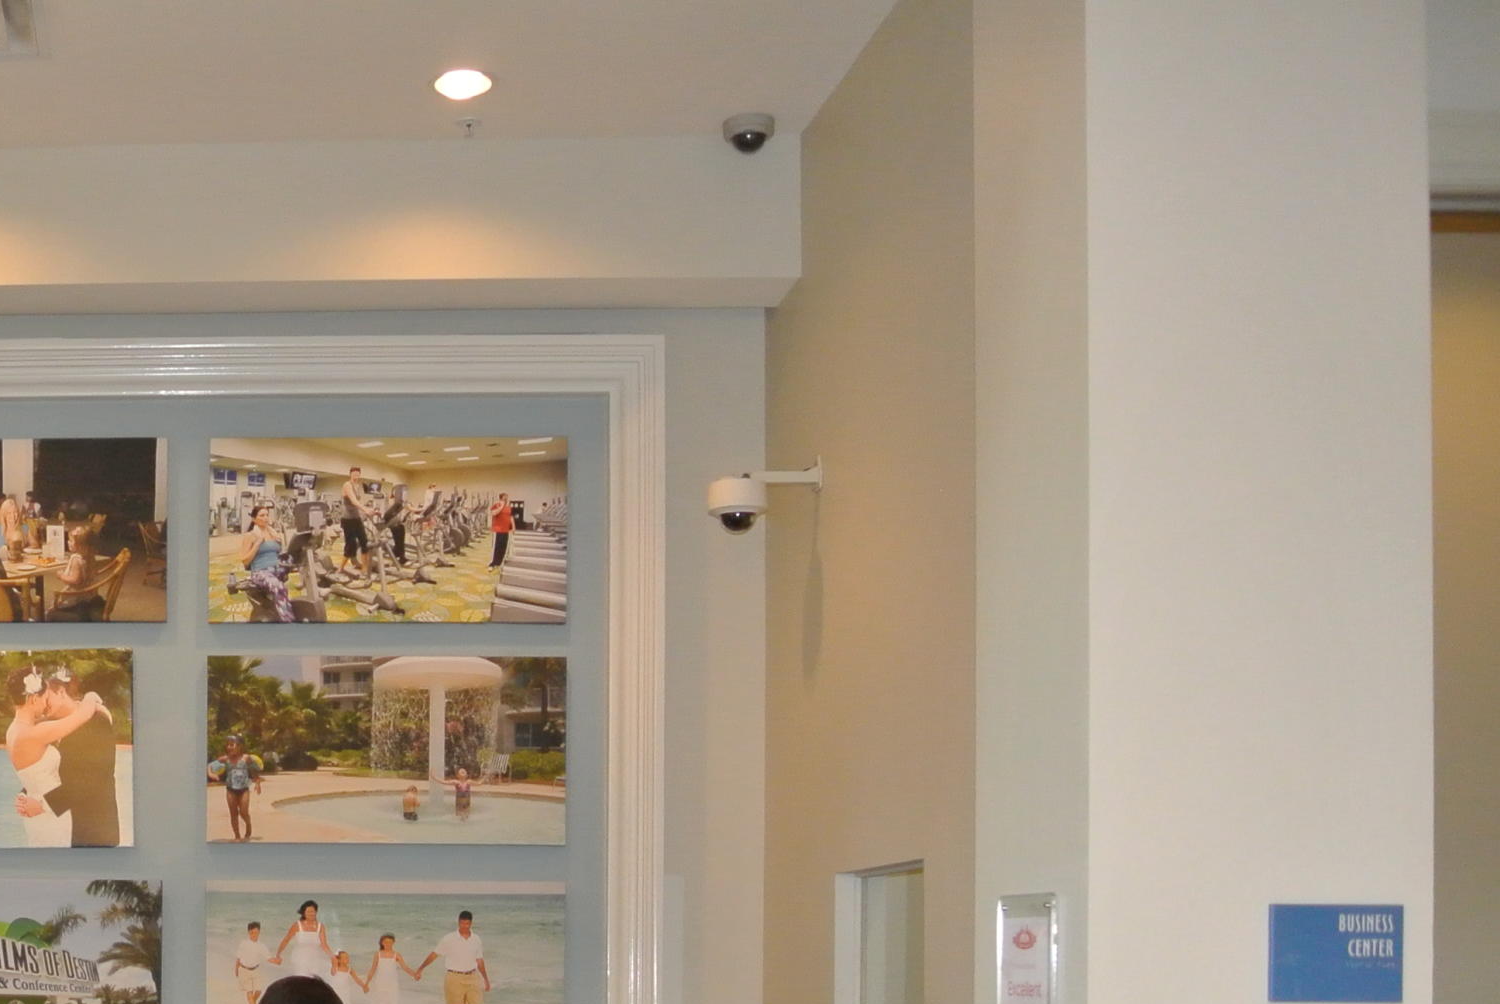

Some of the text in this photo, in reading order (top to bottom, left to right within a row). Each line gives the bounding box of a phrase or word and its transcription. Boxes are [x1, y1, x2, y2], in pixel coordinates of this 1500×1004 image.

[1338, 913, 1394, 933] BUSINESS
[1348, 938, 1394, 957] CENTER
[43, 949, 61, 977] OF
[12, 978, 68, 993] Conference
